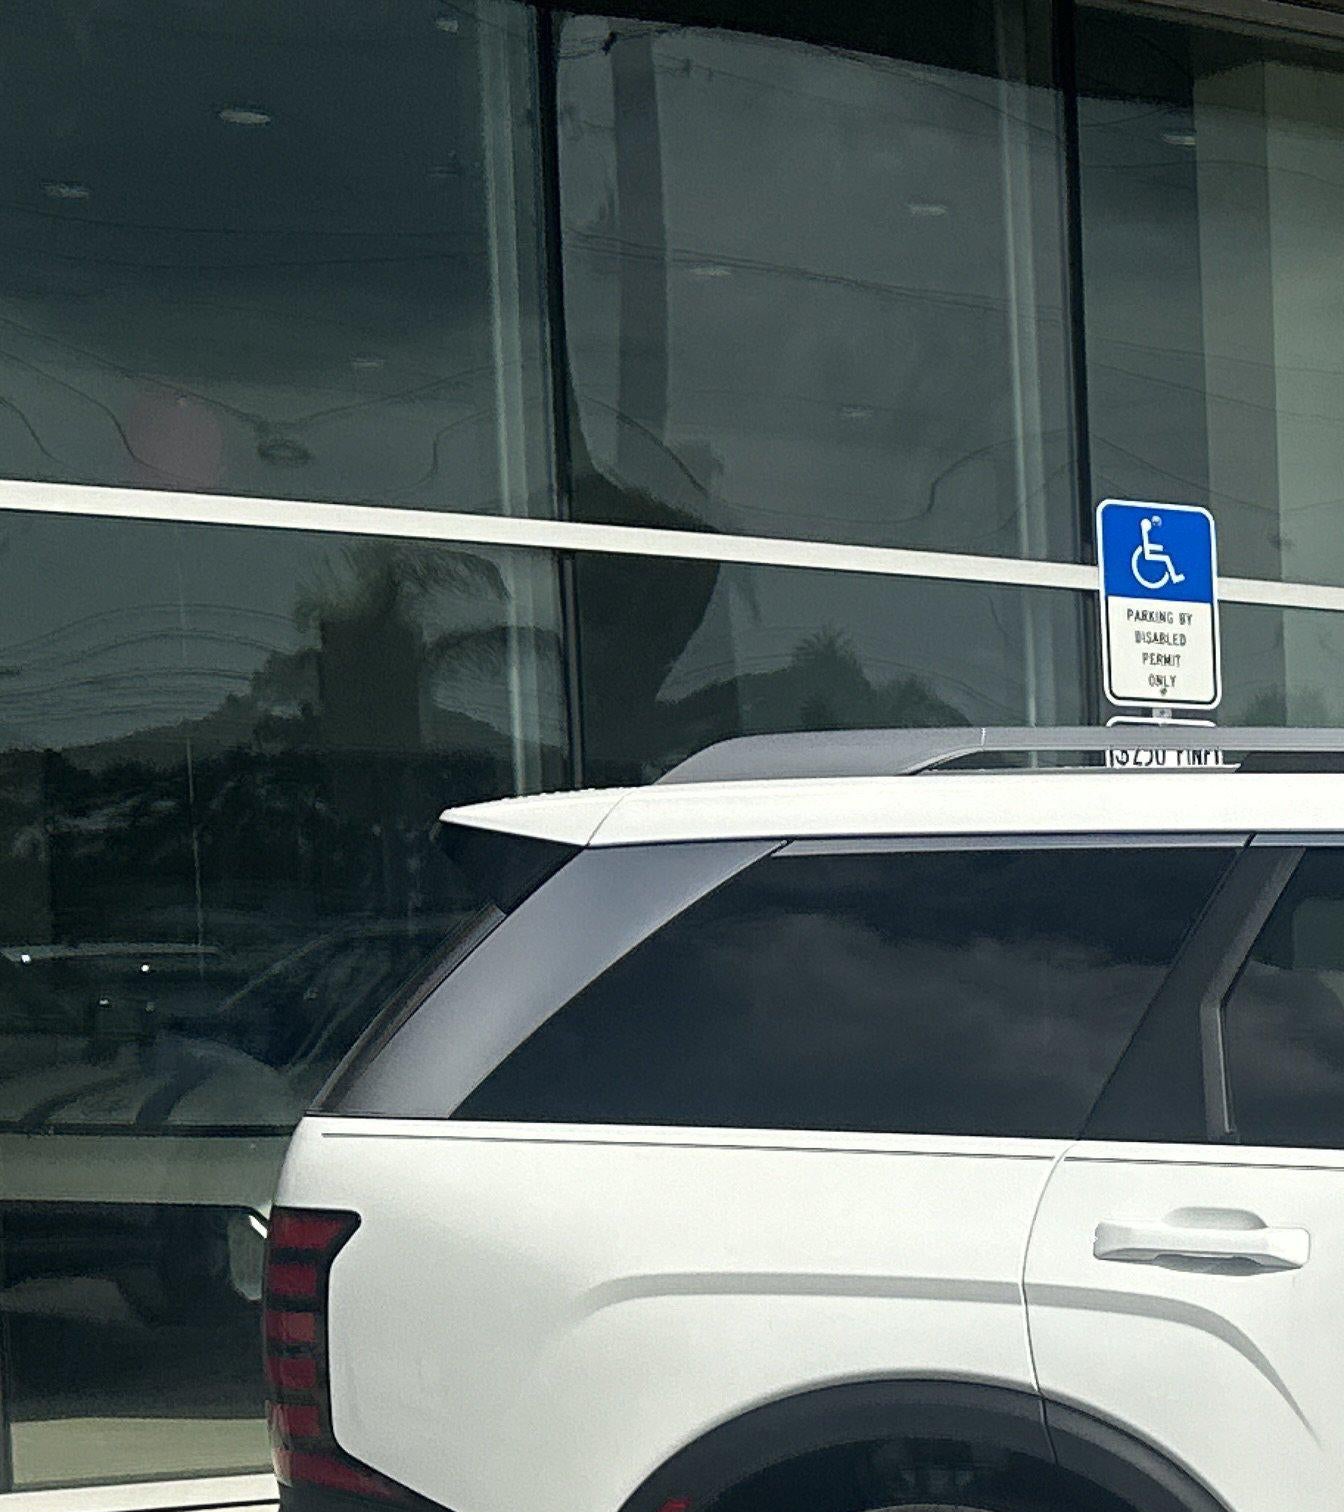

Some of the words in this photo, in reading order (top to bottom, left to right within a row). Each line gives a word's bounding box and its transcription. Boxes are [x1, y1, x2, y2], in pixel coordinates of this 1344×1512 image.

[1126, 607, 1174, 625] PARKING
[1178, 612, 1193, 626] BY
[1134, 630, 1187, 647] DISABLED
[1141, 651, 1181, 668] PERMIT
[1147, 672, 1177, 688] ONLY
